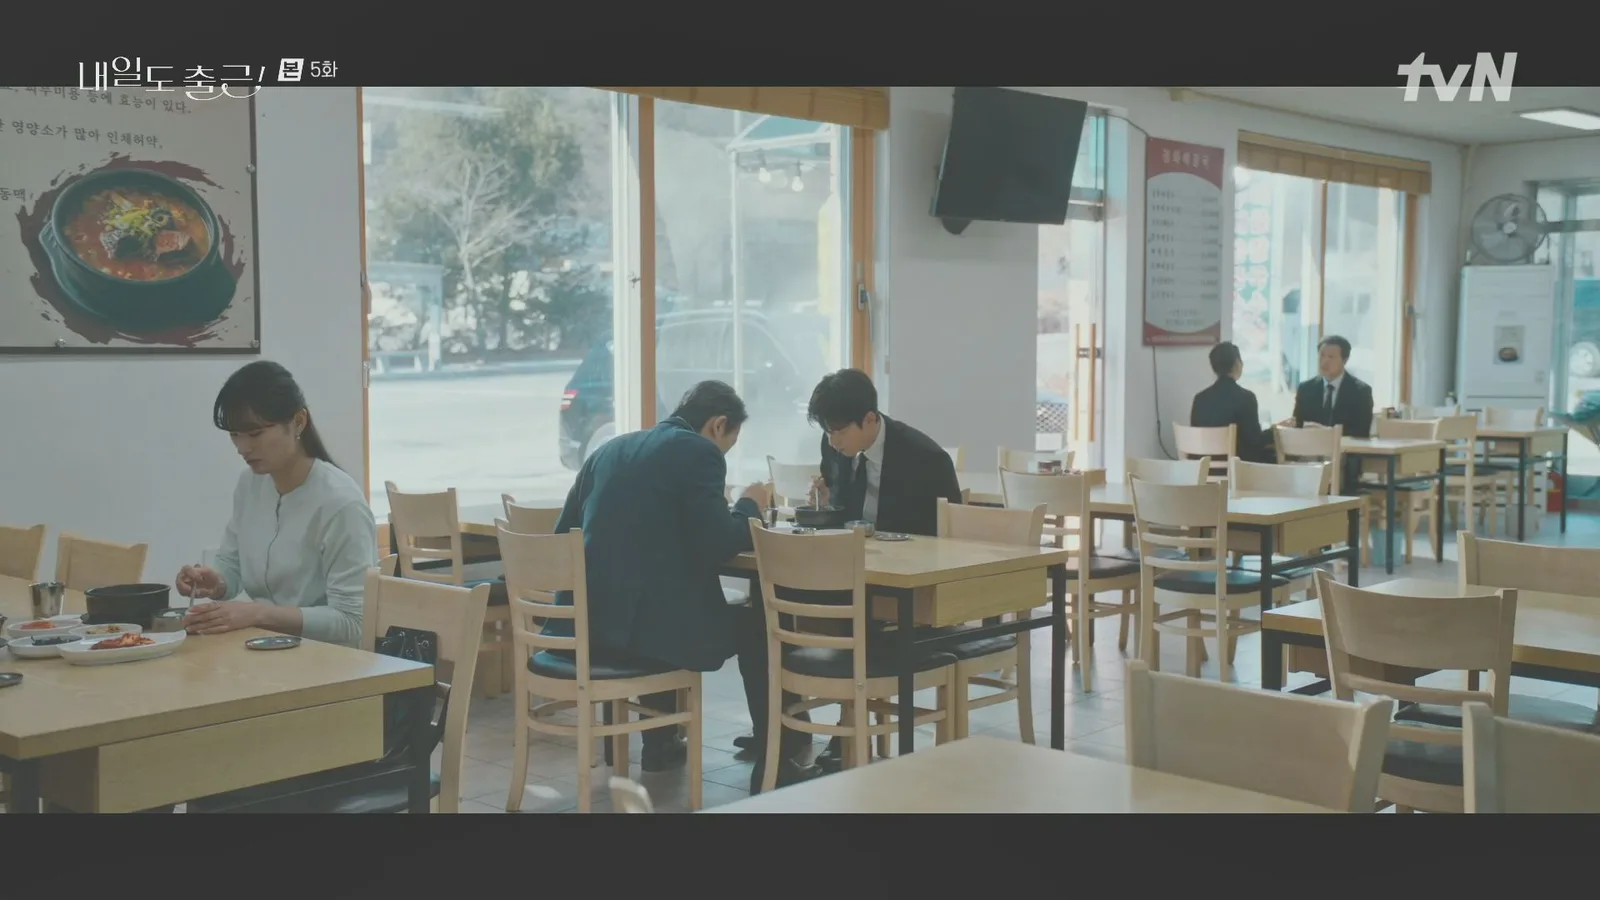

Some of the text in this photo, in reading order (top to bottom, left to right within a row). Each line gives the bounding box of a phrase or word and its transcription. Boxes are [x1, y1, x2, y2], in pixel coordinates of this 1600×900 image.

[119, 93, 157, 111] 효능이
[162, 99, 192, 115] 있다.
[11, 119, 69, 140] 영양소가
[74, 127, 102, 143] 많아
